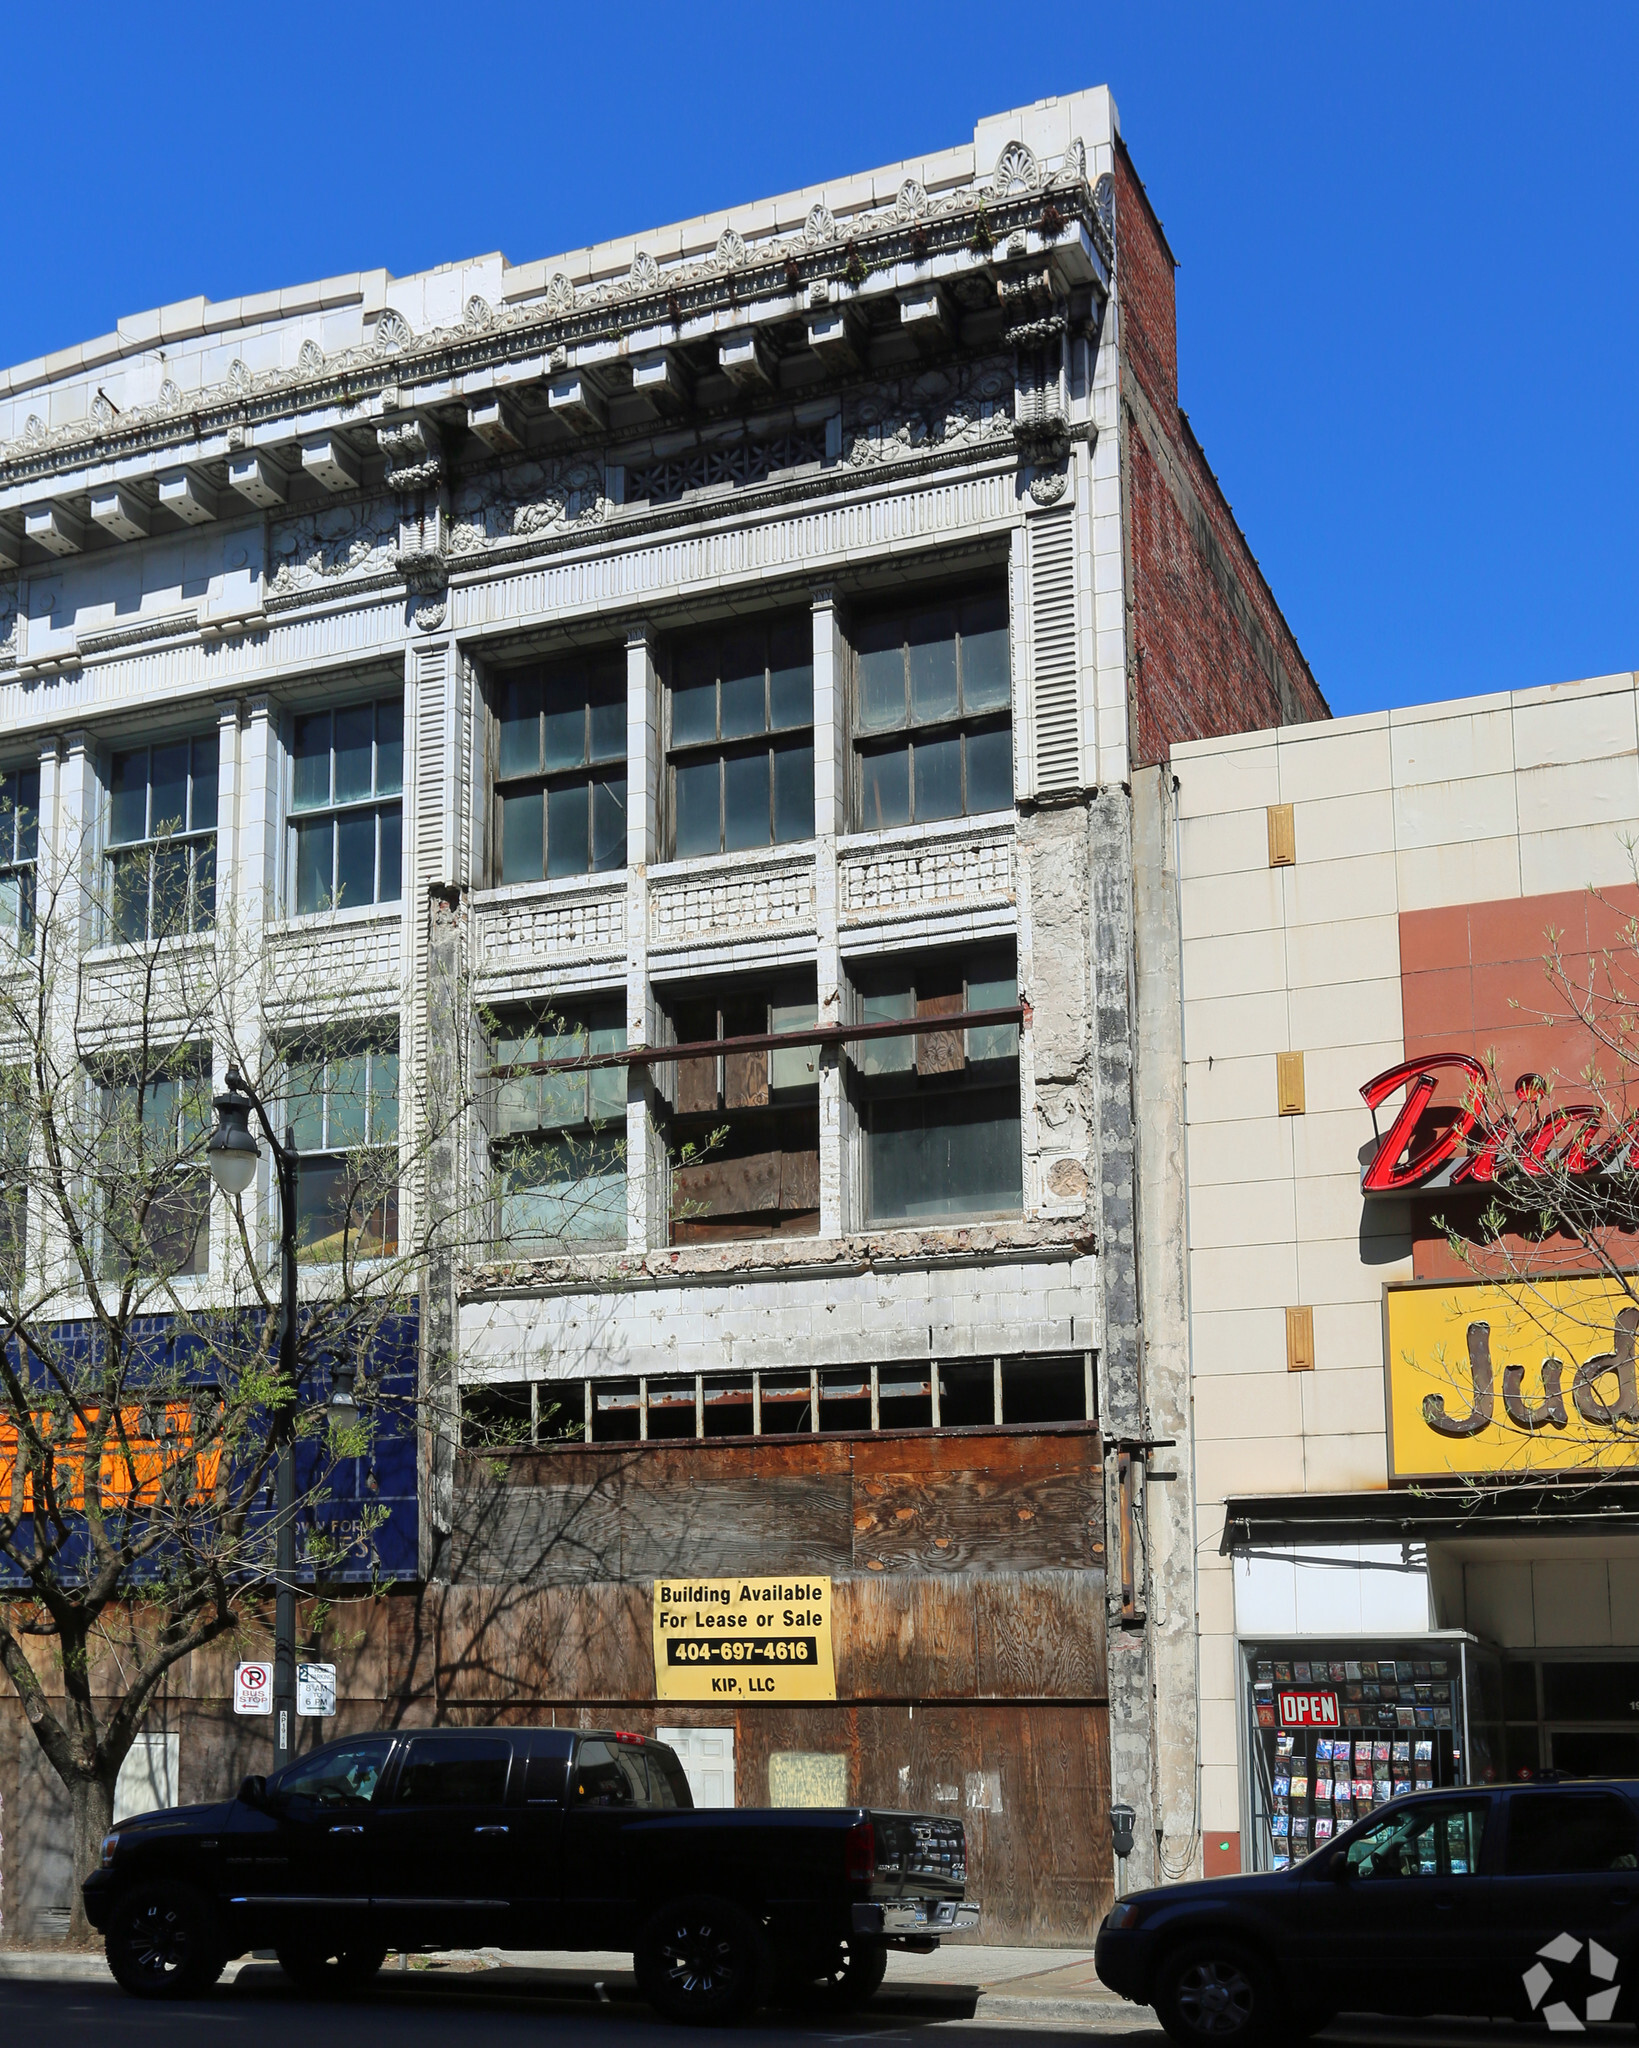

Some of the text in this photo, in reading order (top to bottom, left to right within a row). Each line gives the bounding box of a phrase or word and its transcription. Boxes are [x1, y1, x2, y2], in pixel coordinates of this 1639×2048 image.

[1359, 1052, 1639, 1190] Dia
[660, 1584, 823, 1605] Building Available
[659, 1610, 823, 1628] For Lease or Sale
[675, 1641, 808, 1660] 404-697-4616
[300, 1667, 308, 1680] 2
[305, 1684, 328, 1692] 8 AM
[711, 1677, 775, 1695] KIP, LLC
[1282, 1696, 1336, 1723] OPEN
